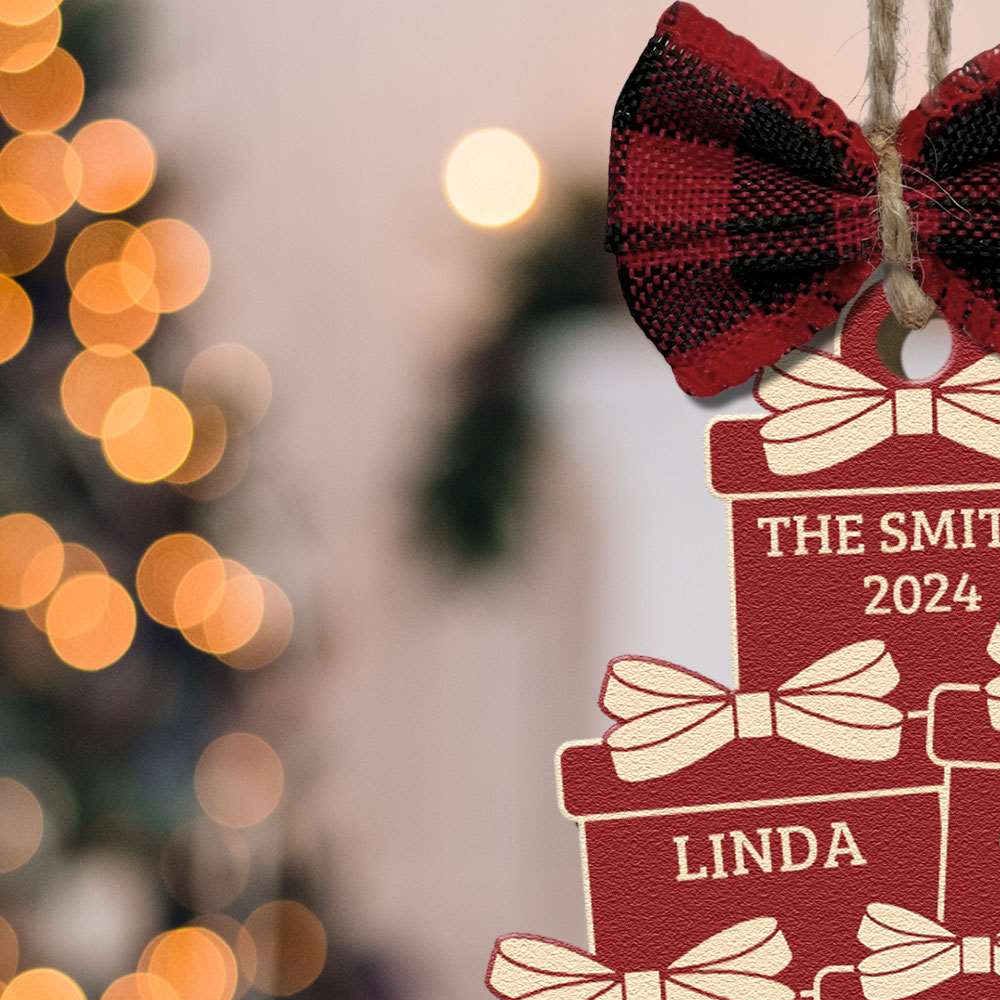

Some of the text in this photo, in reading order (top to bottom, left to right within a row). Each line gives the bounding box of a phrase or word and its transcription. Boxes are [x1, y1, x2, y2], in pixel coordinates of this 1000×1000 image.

[757, 514, 865, 557] THE
[864, 573, 982, 614] 2024
[673, 821, 867, 881] LINDA
